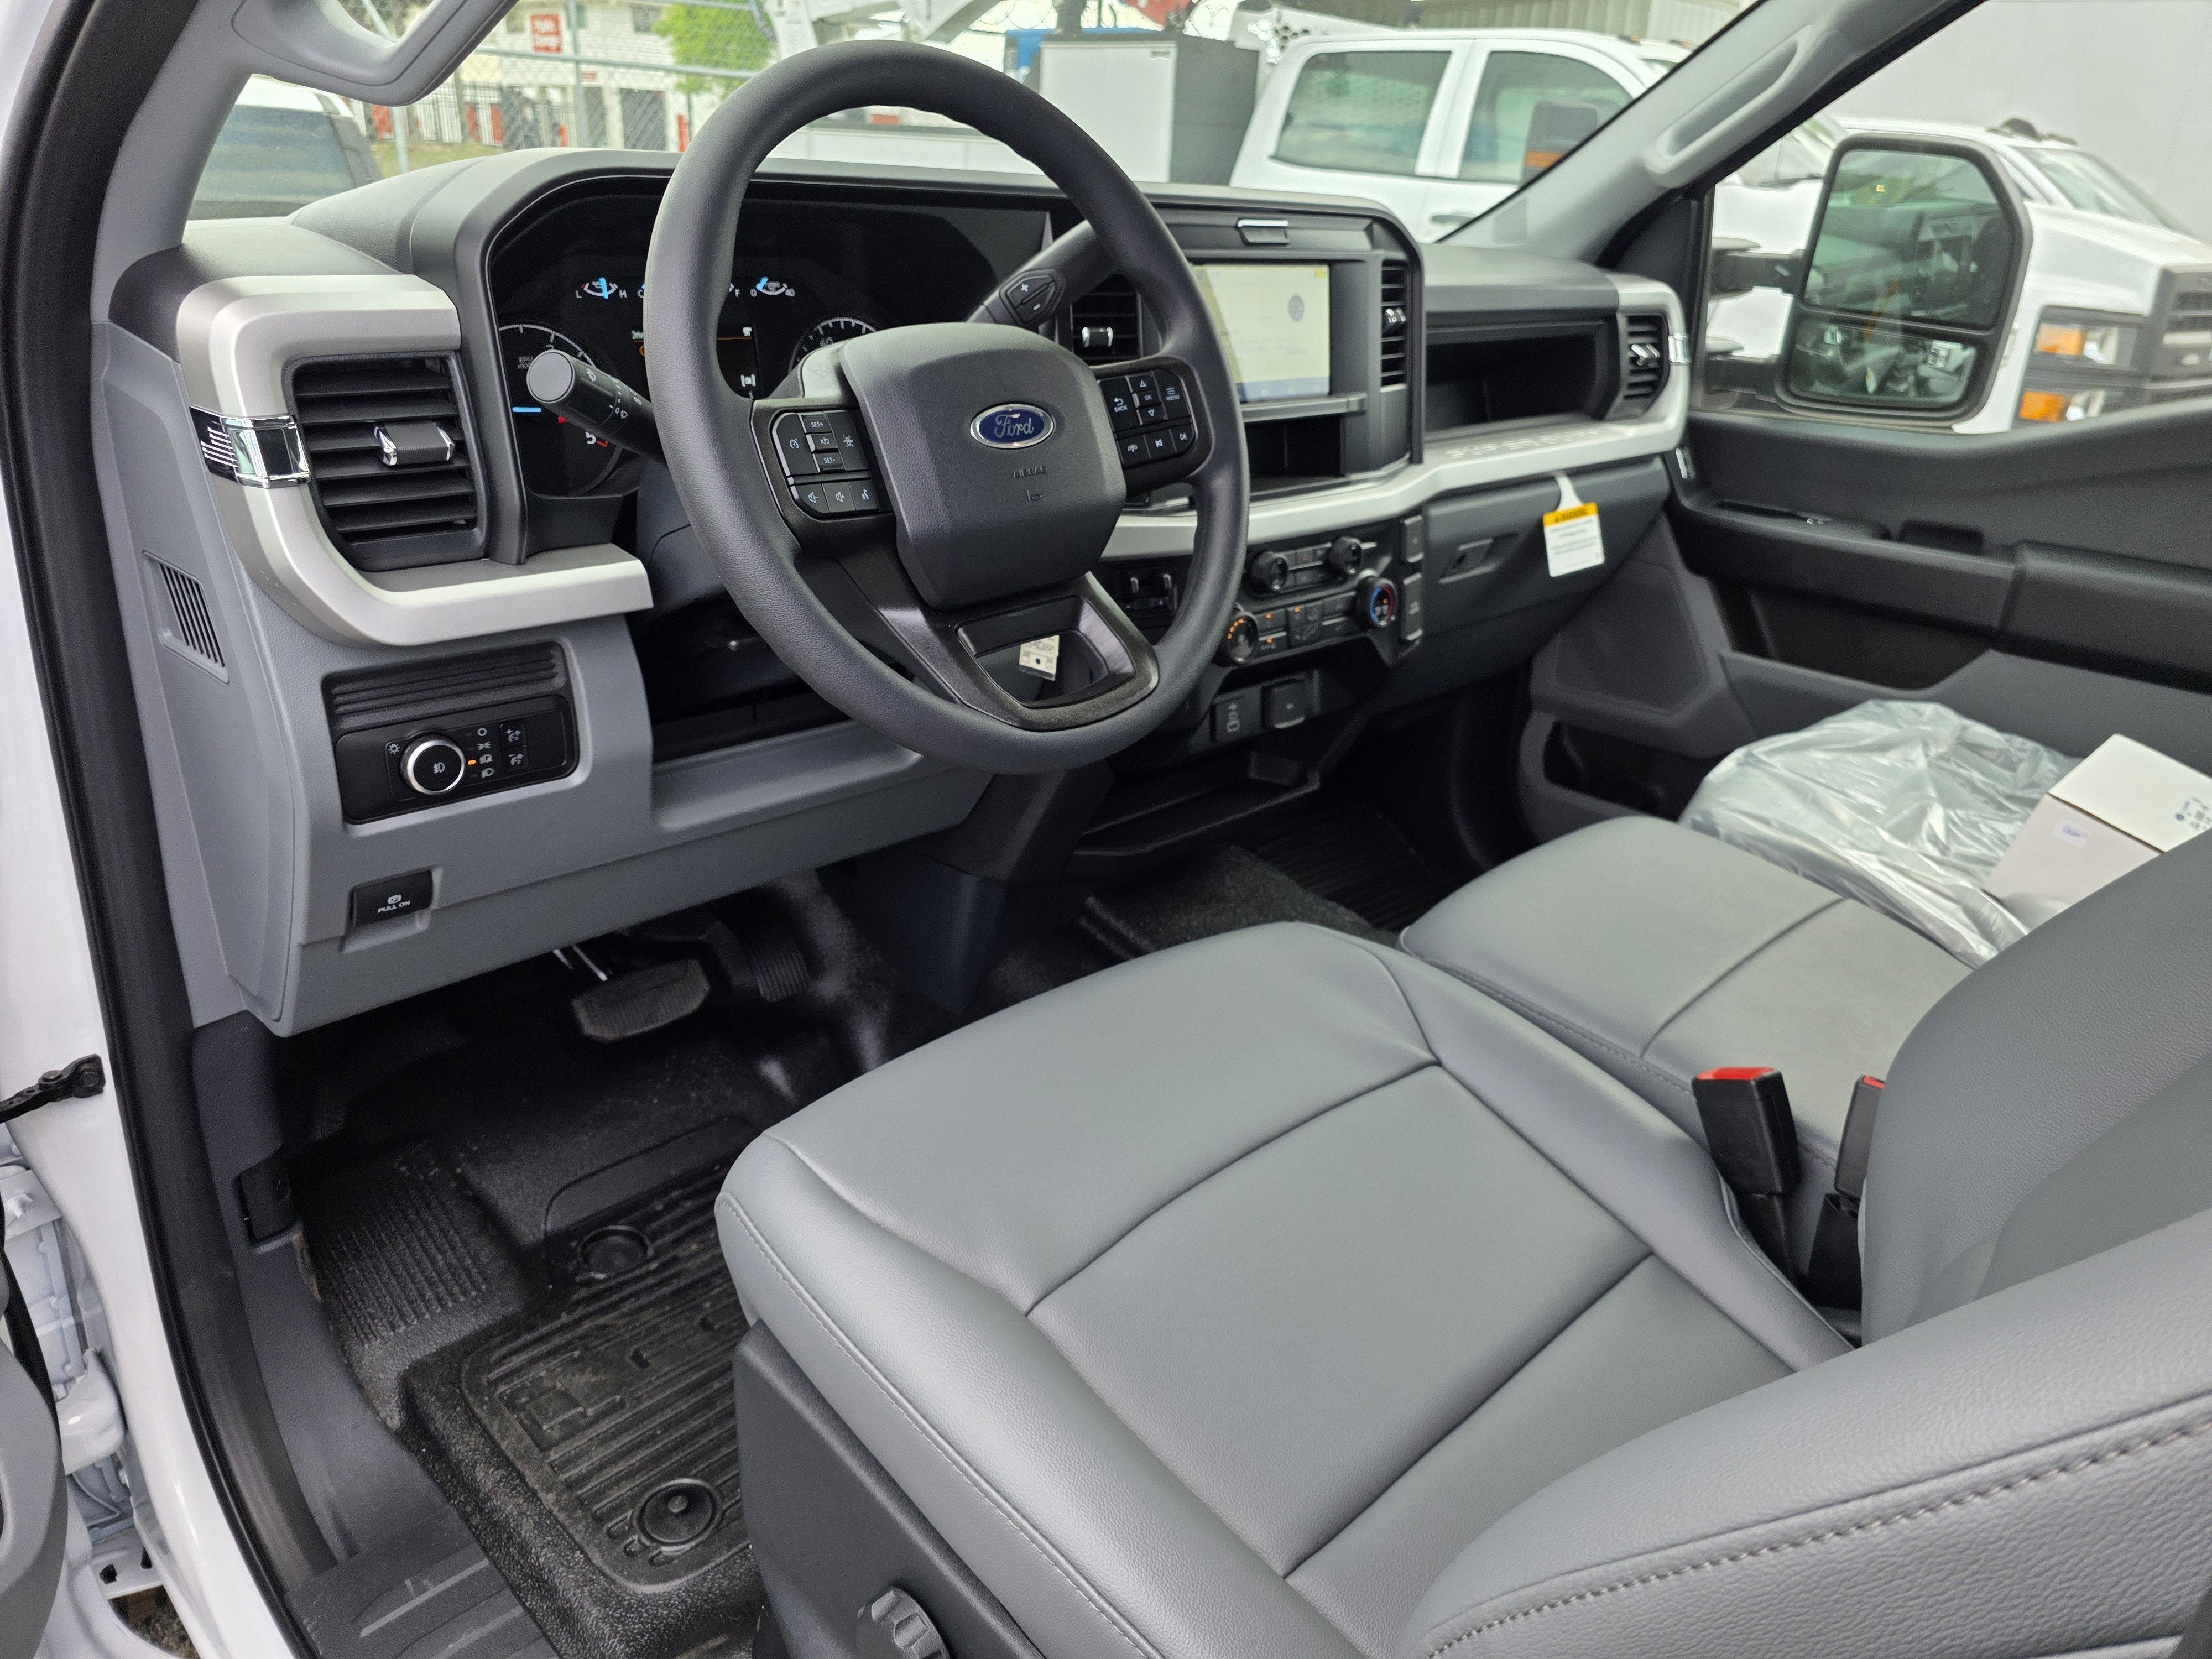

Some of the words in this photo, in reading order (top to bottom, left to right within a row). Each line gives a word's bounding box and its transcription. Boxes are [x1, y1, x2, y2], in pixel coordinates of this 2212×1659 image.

[575, 289, 582, 299] L
[619, 289, 627, 298] H
[734, 288, 740, 298] F
[994, 413, 1035, 439] Ford
[585, 431, 597, 445] 5
[377, 904, 398, 913] PULL
